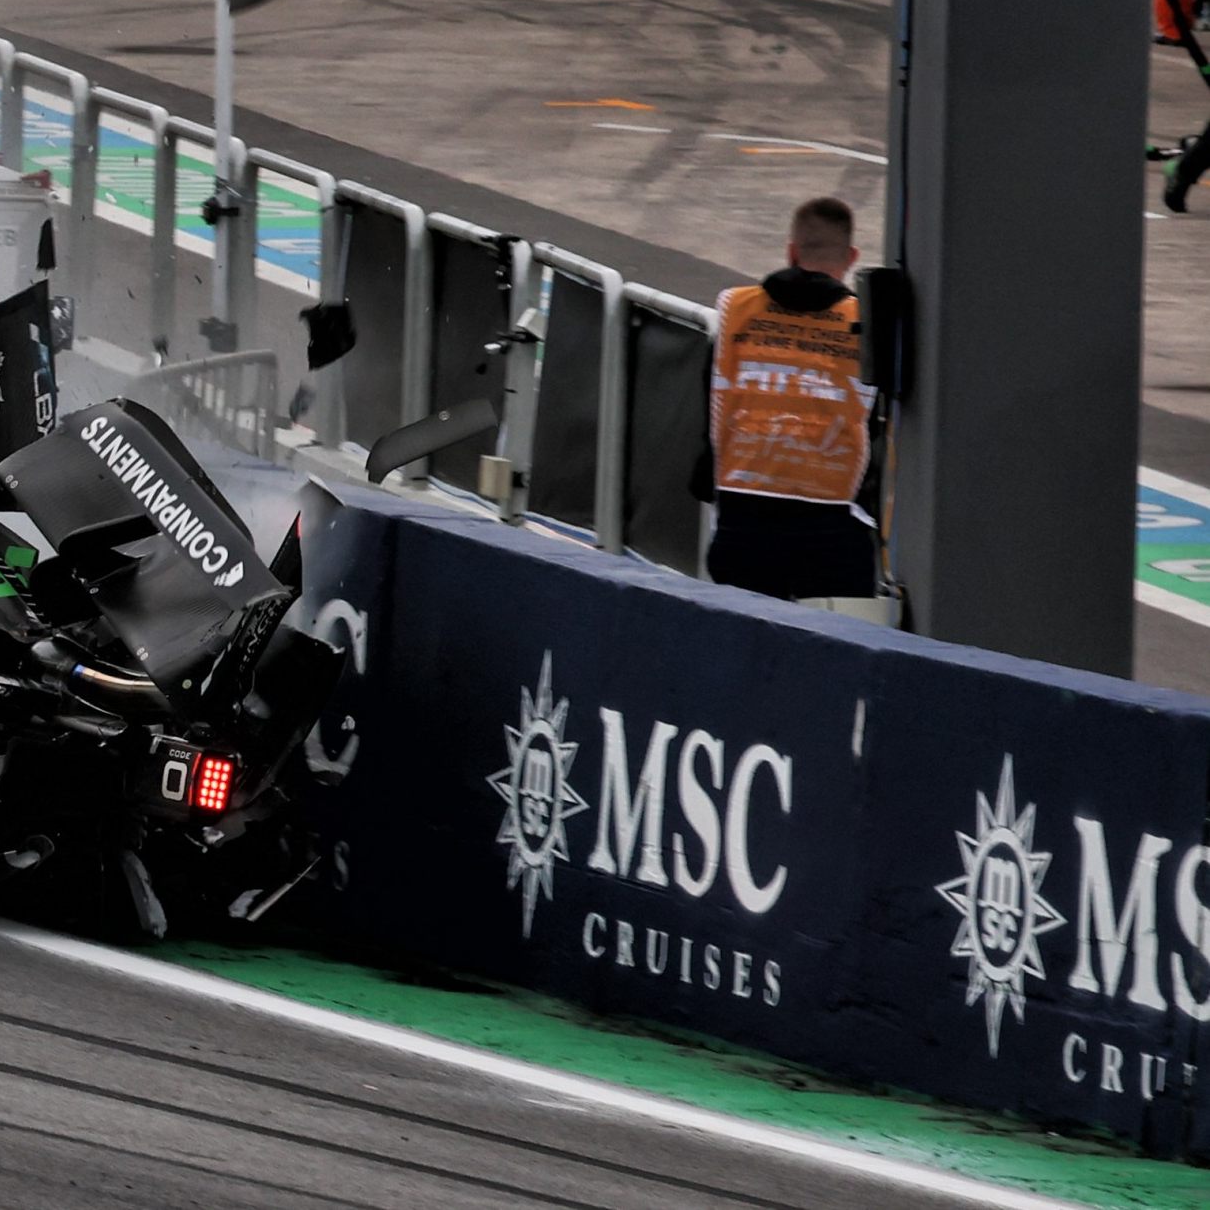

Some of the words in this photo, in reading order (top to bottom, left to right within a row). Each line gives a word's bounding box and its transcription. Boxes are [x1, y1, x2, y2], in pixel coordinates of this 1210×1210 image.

[81, 416, 230, 574] COINPAYMENTS
[161, 760, 188, 801] 0
[169, 748, 192, 760] CODE
[587, 706, 792, 914] MSC
[582, 912, 782, 1007] CRUISES
